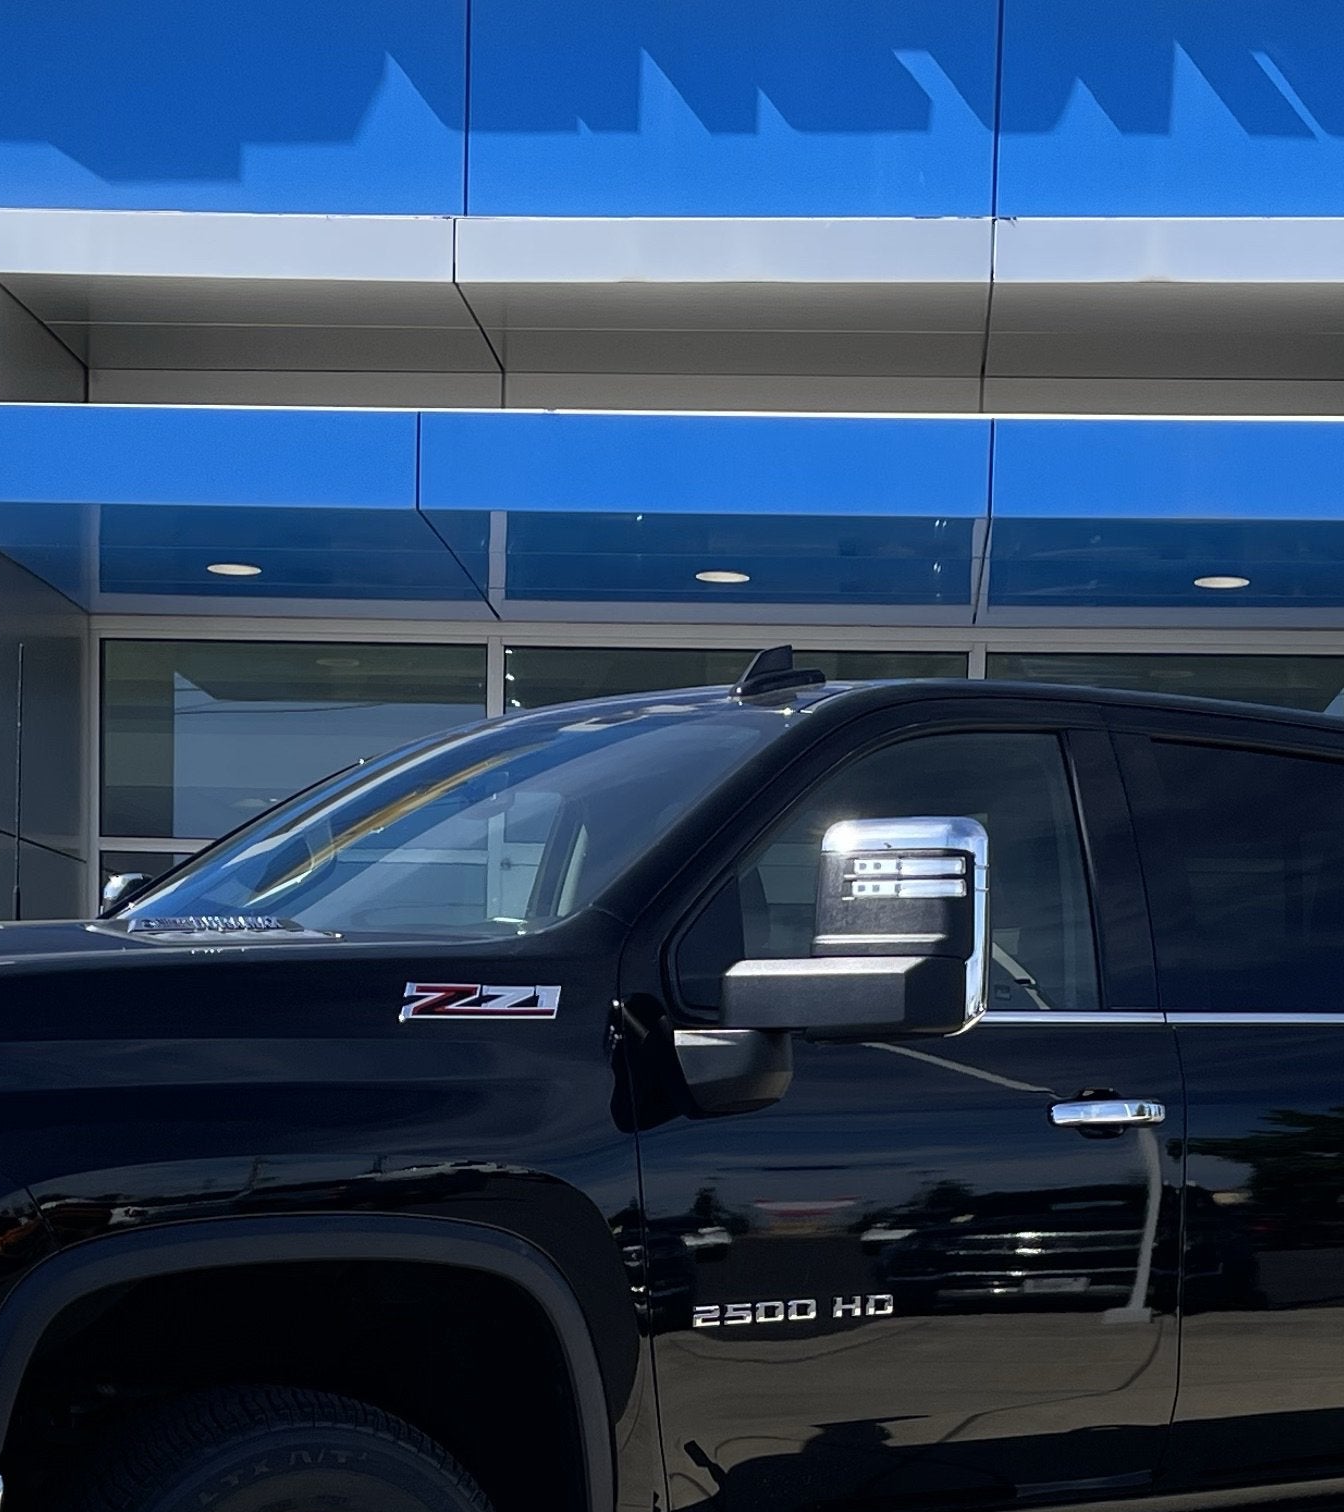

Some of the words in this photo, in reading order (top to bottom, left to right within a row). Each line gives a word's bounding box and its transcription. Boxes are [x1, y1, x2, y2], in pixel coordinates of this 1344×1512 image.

[398, 982, 562, 1023] Z71
[693, 1298, 817, 1328] 2500
[832, 1294, 894, 1318] HD
